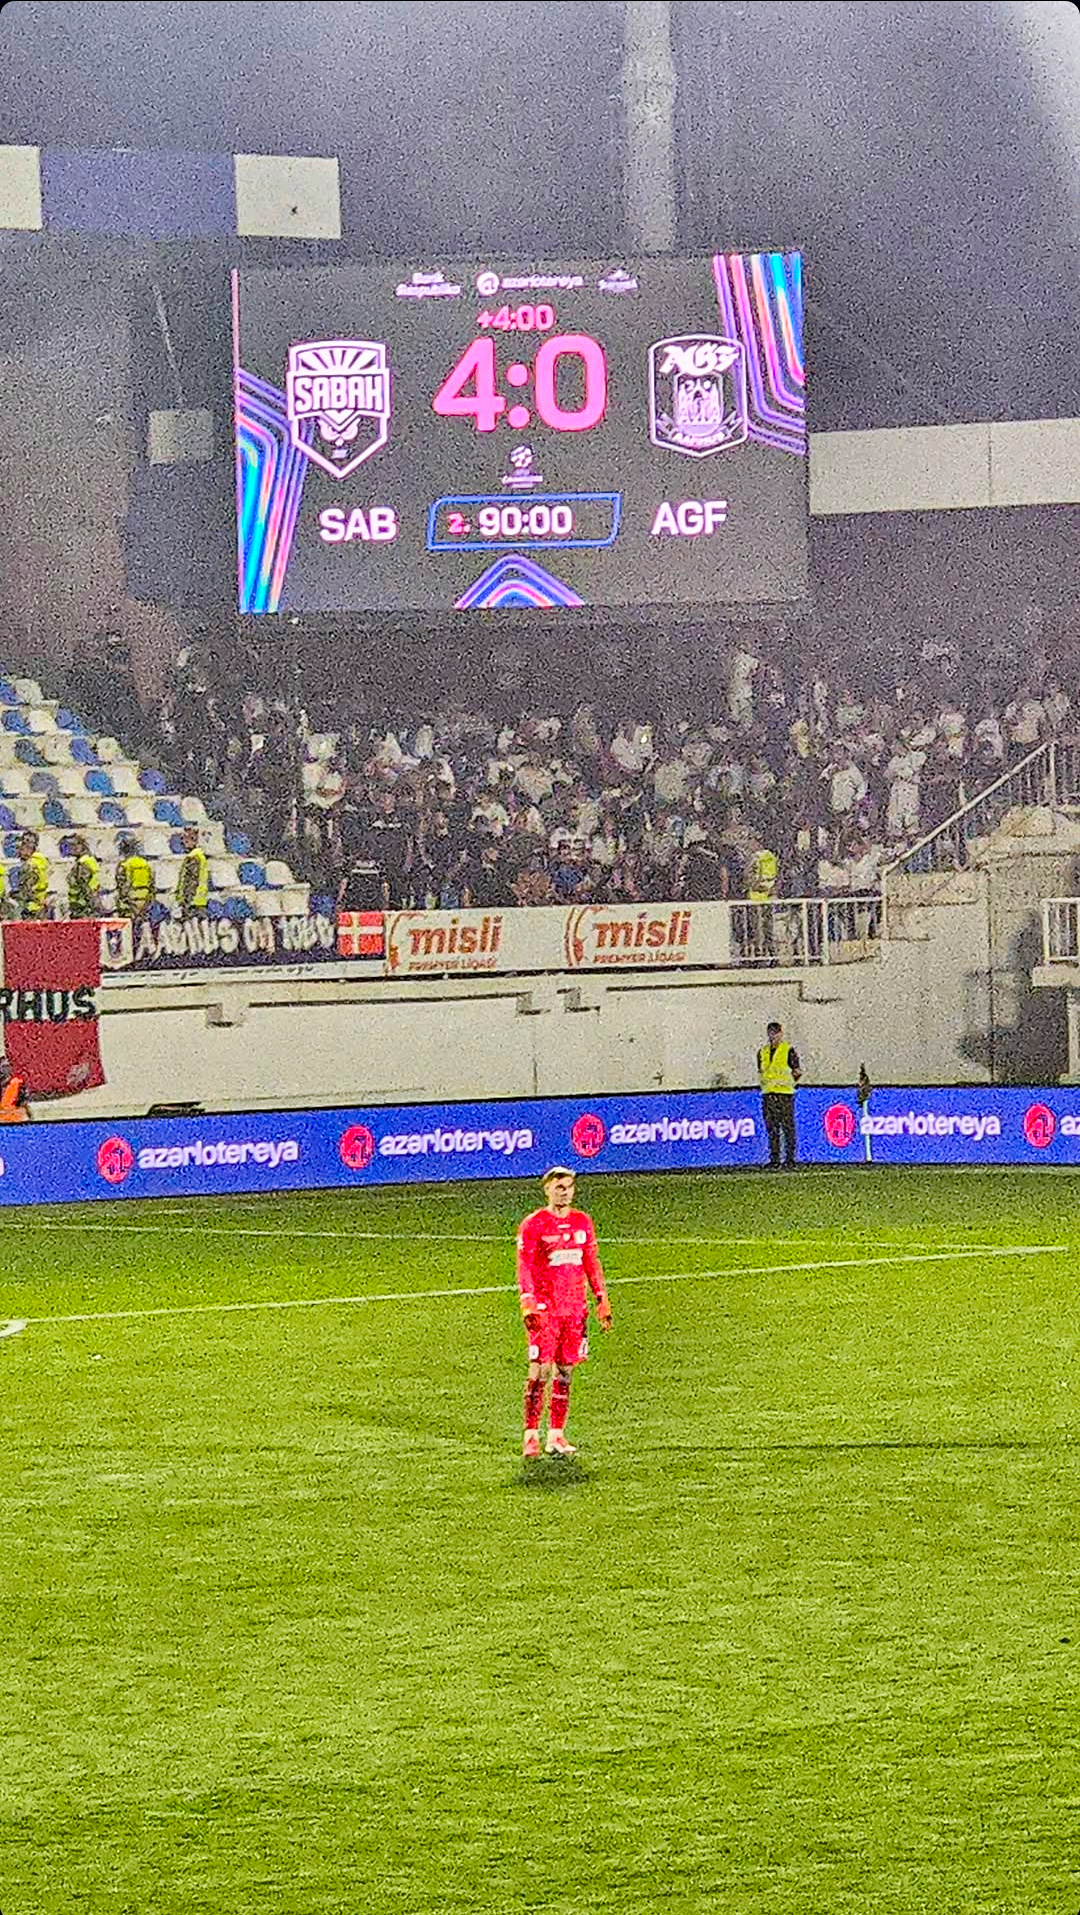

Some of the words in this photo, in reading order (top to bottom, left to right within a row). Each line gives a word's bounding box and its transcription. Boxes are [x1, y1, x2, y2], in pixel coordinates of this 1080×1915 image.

[476, 304, 556, 331] +4:00
[294, 375, 384, 412] SABAH
[433, 334, 607, 432] 4:0
[319, 506, 398, 543] SAB
[478, 505, 574, 537] 90:00
[650, 500, 728, 536] AGF
[408, 914, 503, 956] misli
[593, 910, 692, 949] misli
